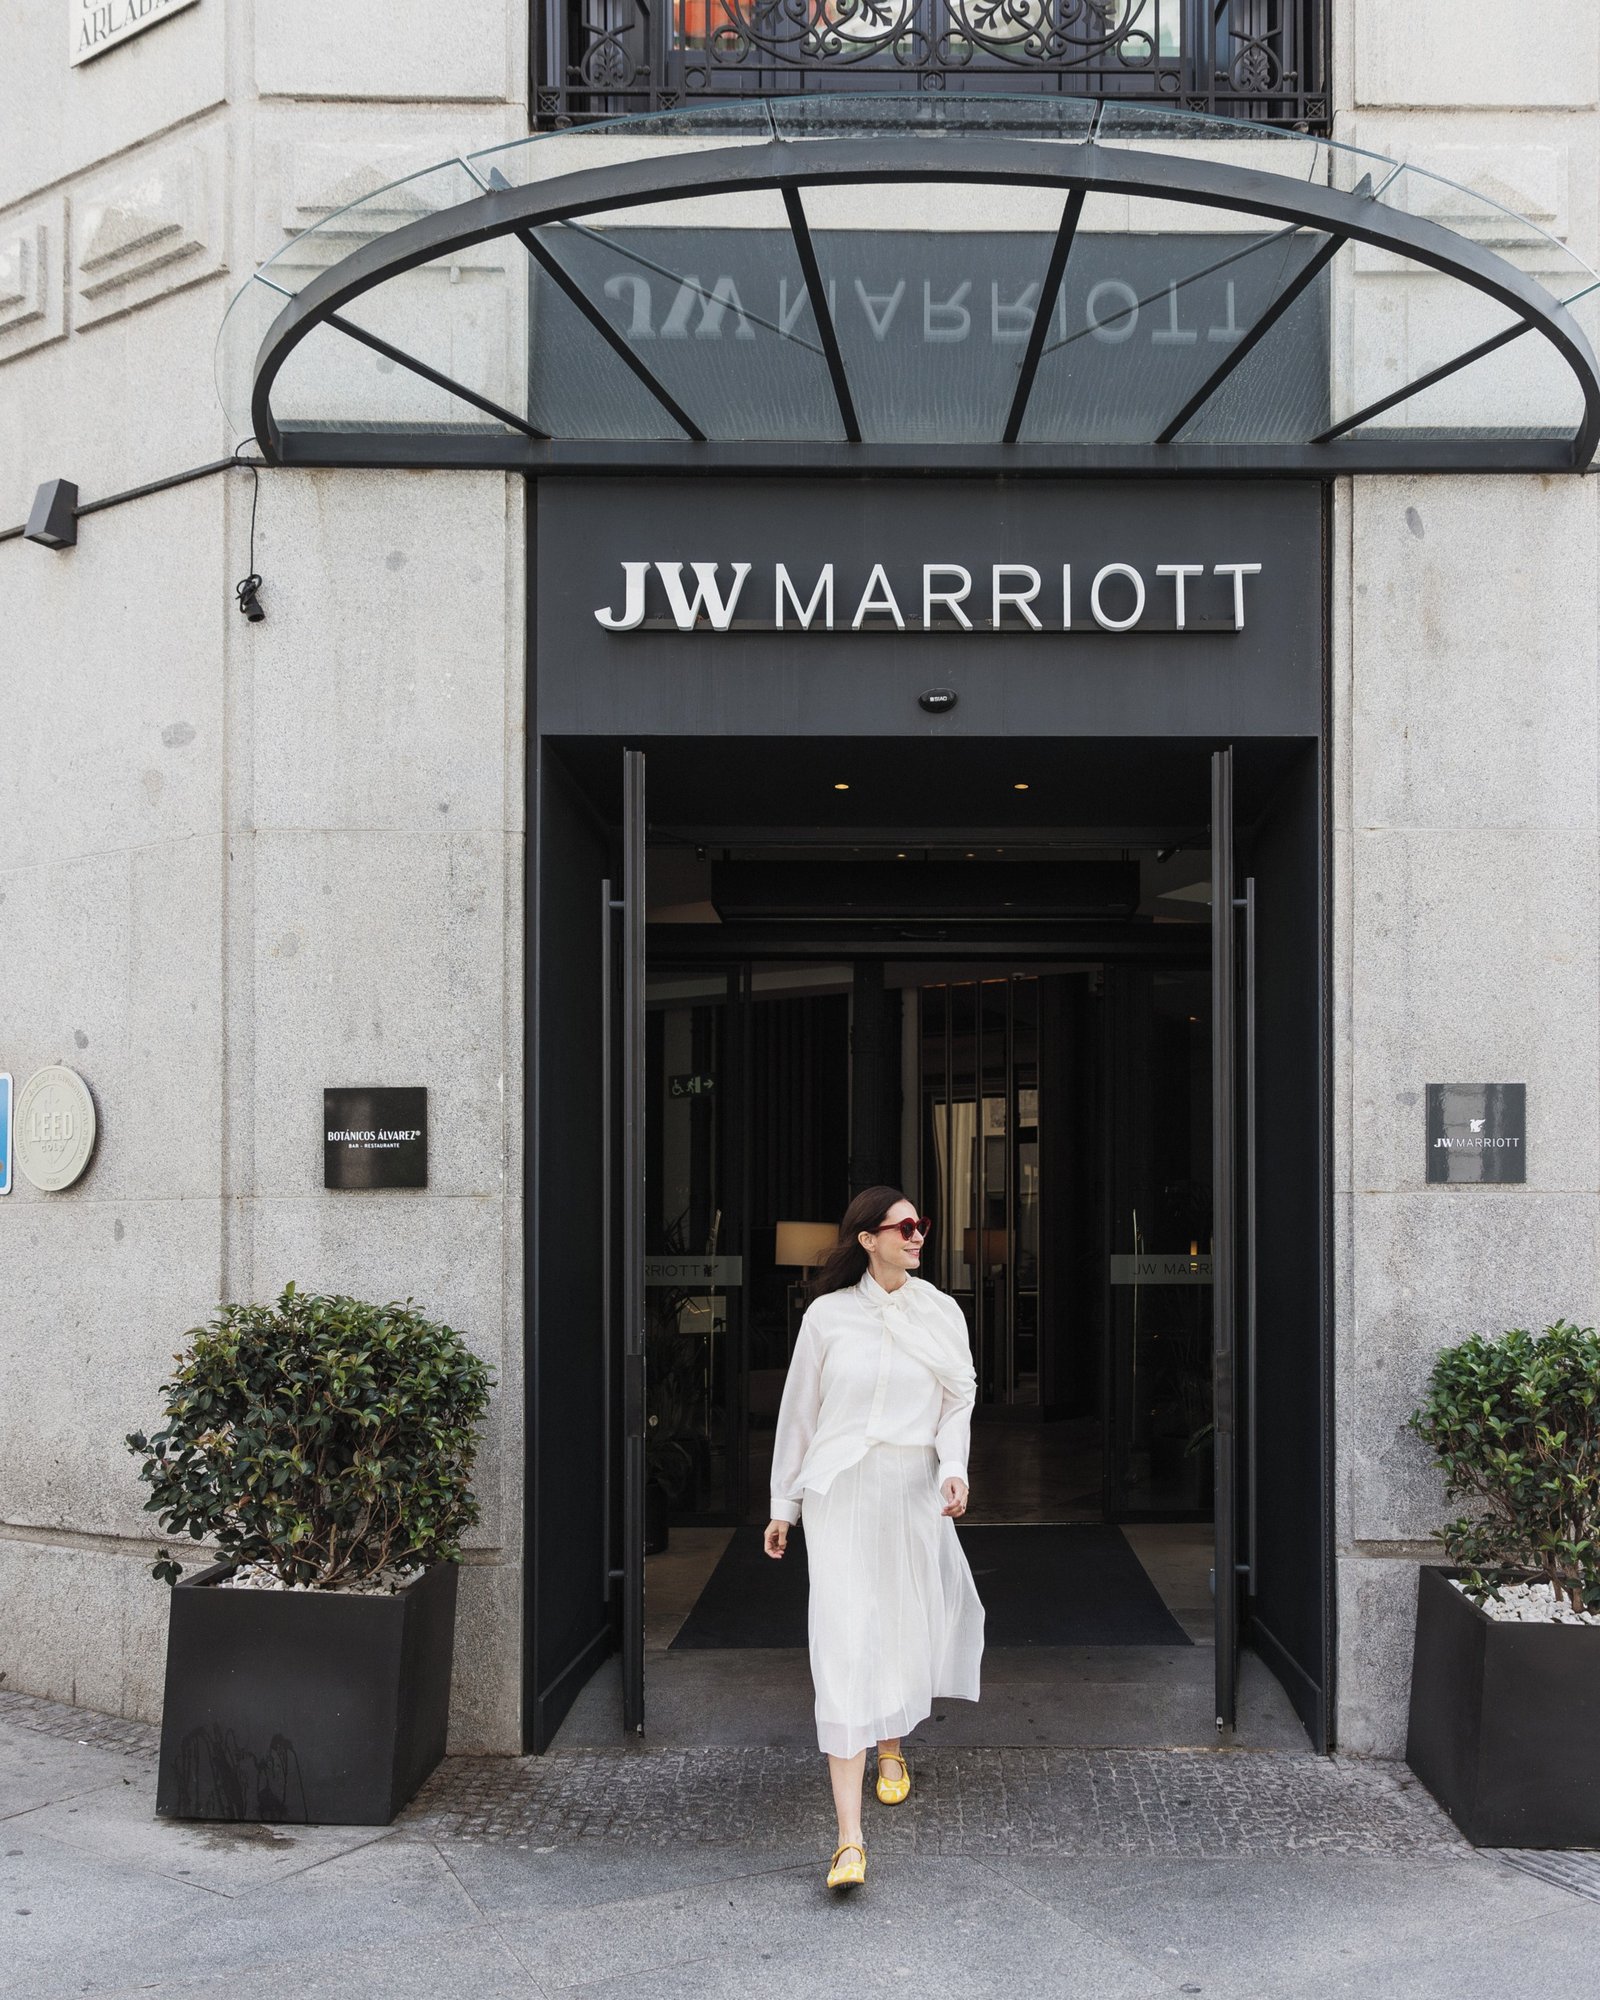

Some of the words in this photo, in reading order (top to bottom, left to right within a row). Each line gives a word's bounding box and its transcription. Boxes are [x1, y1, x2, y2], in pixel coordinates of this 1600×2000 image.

[594, 561, 752, 631] JW
[775, 562, 1262, 632] MARRIOTT
[327, 1128, 376, 1141] BOTÁNICOS
[1433, 1138, 1454, 1148] JW
[1456, 1138, 1520, 1148] MARRIOTT
